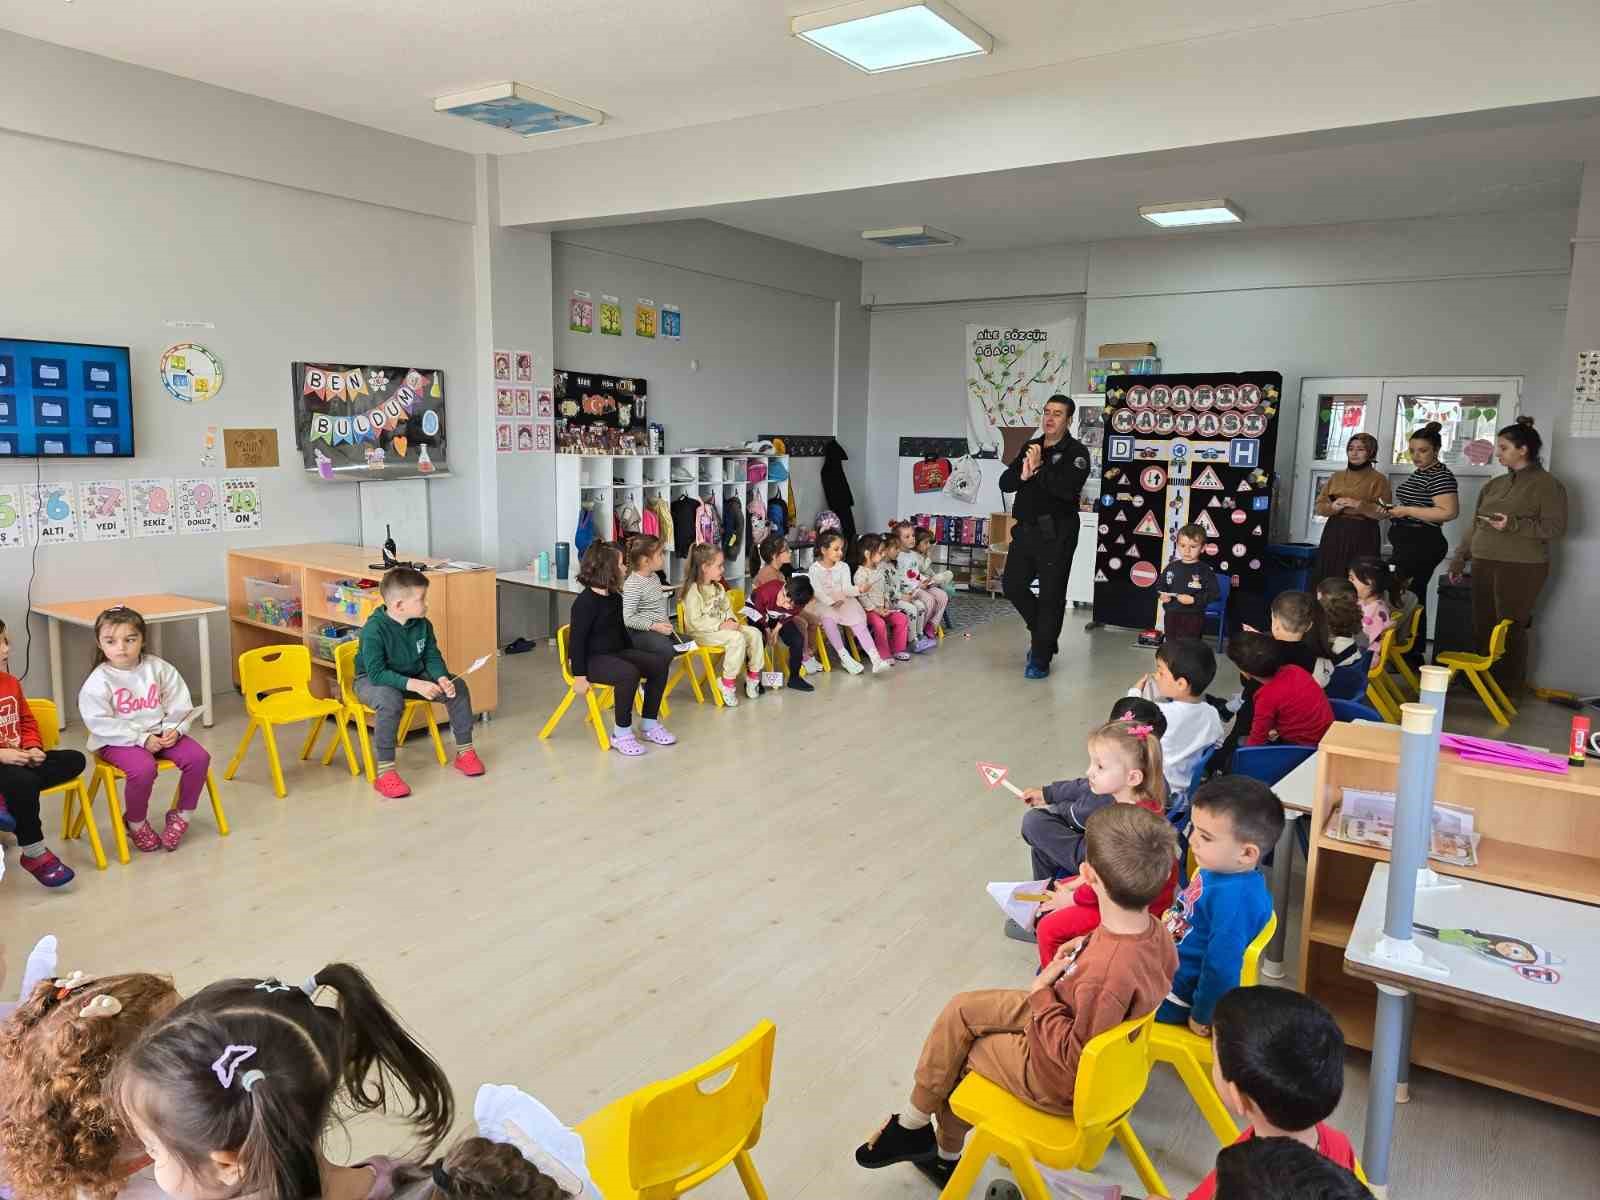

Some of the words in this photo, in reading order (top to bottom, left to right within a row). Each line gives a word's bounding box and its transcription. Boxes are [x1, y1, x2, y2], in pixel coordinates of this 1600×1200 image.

[977, 328, 999, 340] AİLE
[1004, 328, 1048, 342] SÖZCÜK
[975, 343, 1016, 357] AĞACI
[310, 371, 361, 391] BEN
[317, 387, 413, 436] BULDUM
[1234, 442, 1255, 464] H
[47, 488, 71, 521] 6
[148, 486, 170, 514] 8
[235, 514, 250, 523] ON
[42, 526, 64, 536] ALTI
[114, 683, 160, 714] Barb
